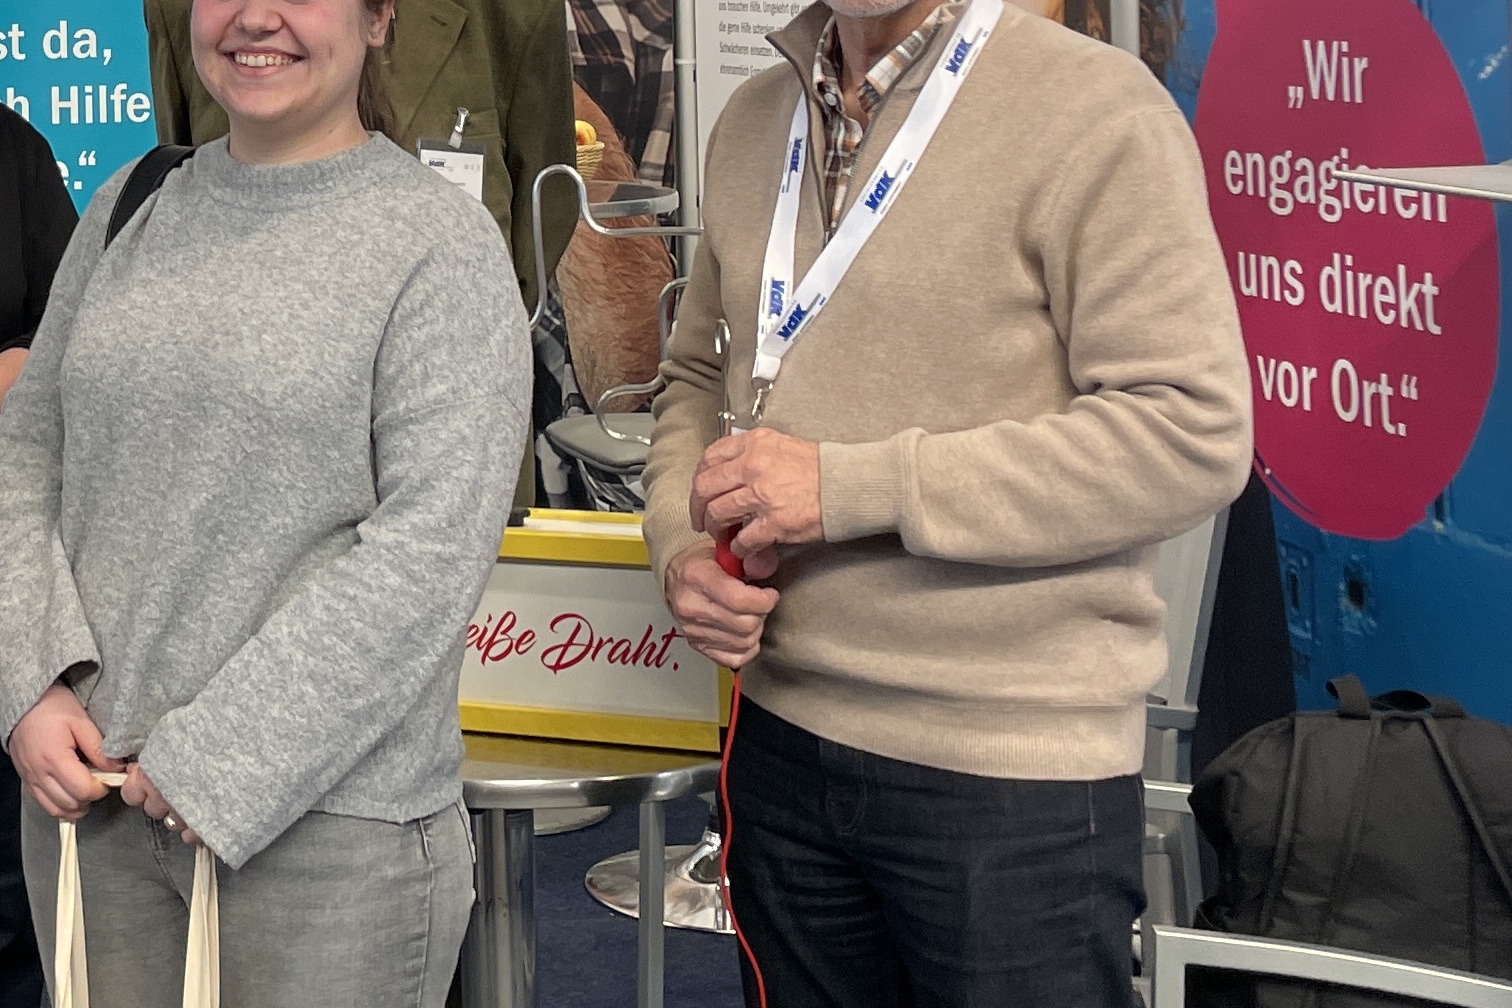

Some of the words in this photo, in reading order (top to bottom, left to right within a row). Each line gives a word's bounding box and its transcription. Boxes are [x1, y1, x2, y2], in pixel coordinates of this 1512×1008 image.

[43, 20, 113, 66] da,
[1288, 39, 1369, 109] „Wir
[50, 82, 151, 124] Hilfe
[864, 169, 896, 213] VdK
[1238, 251, 1305, 306] uns
[1319, 252, 1442, 336] direkt
[1257, 354, 1318, 411] vor
[1330, 357, 1419, 438] Ort.“
[466, 610, 537, 666] eiße
[541, 612, 686, 675] Draht.
